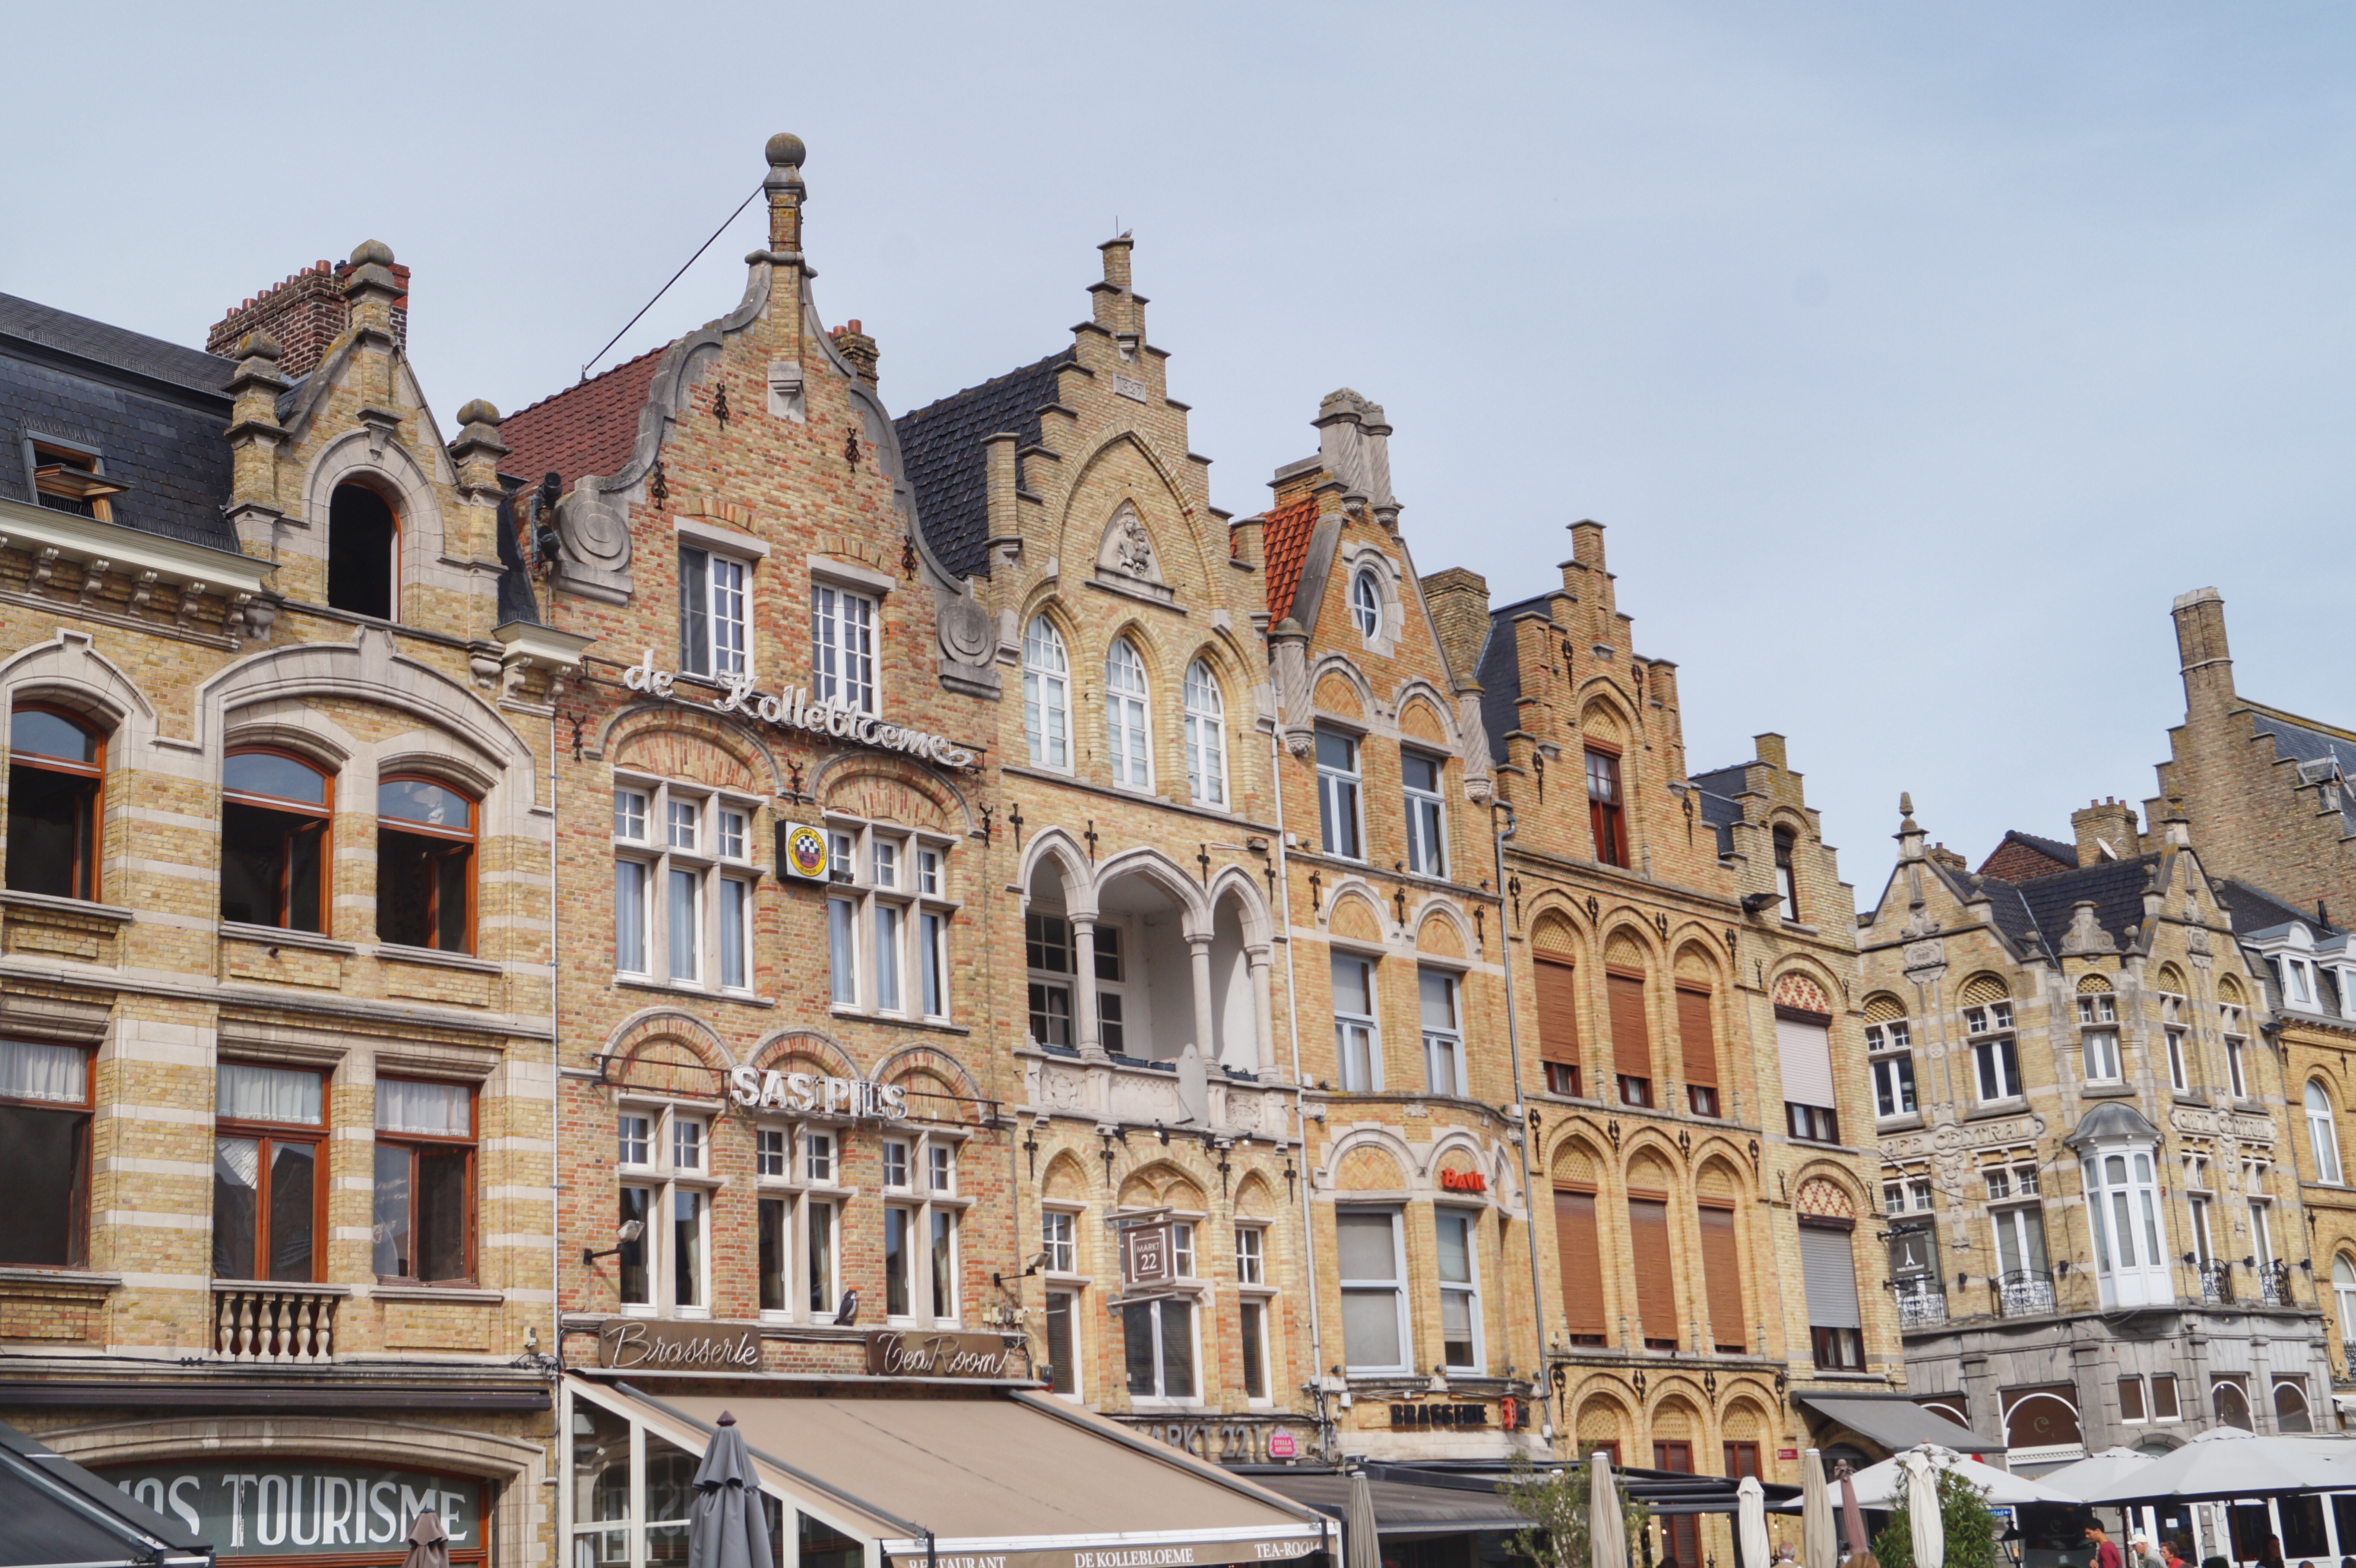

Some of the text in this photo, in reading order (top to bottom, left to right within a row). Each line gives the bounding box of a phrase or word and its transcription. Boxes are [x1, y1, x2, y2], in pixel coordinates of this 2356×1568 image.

[620, 649, 674, 698] de
[793, 829, 812, 839] TARGA
[814, 835, 825, 860] FLORIO
[799, 866, 817, 874] IEPER
[730, 1065, 908, 1121] SAS PILS
[1879, 1122, 2029, 1157] AFE CENTRAL
[1137, 1242, 1159, 1253] MARKT
[1141, 1253, 1156, 1271] 22
[605, 1322, 758, 1367] Brasserie
[877, 1331, 1010, 1375] Tea Room
[1390, 1404, 1488, 1424] BRASSERIE
[221, 1474, 468, 1547] TOURISME
[908, 1556, 1006, 1568] RETAURANT
[1074, 1552, 1094, 1568] DE
[1096, 1548, 1194, 1568] KOLLEBLOEME
